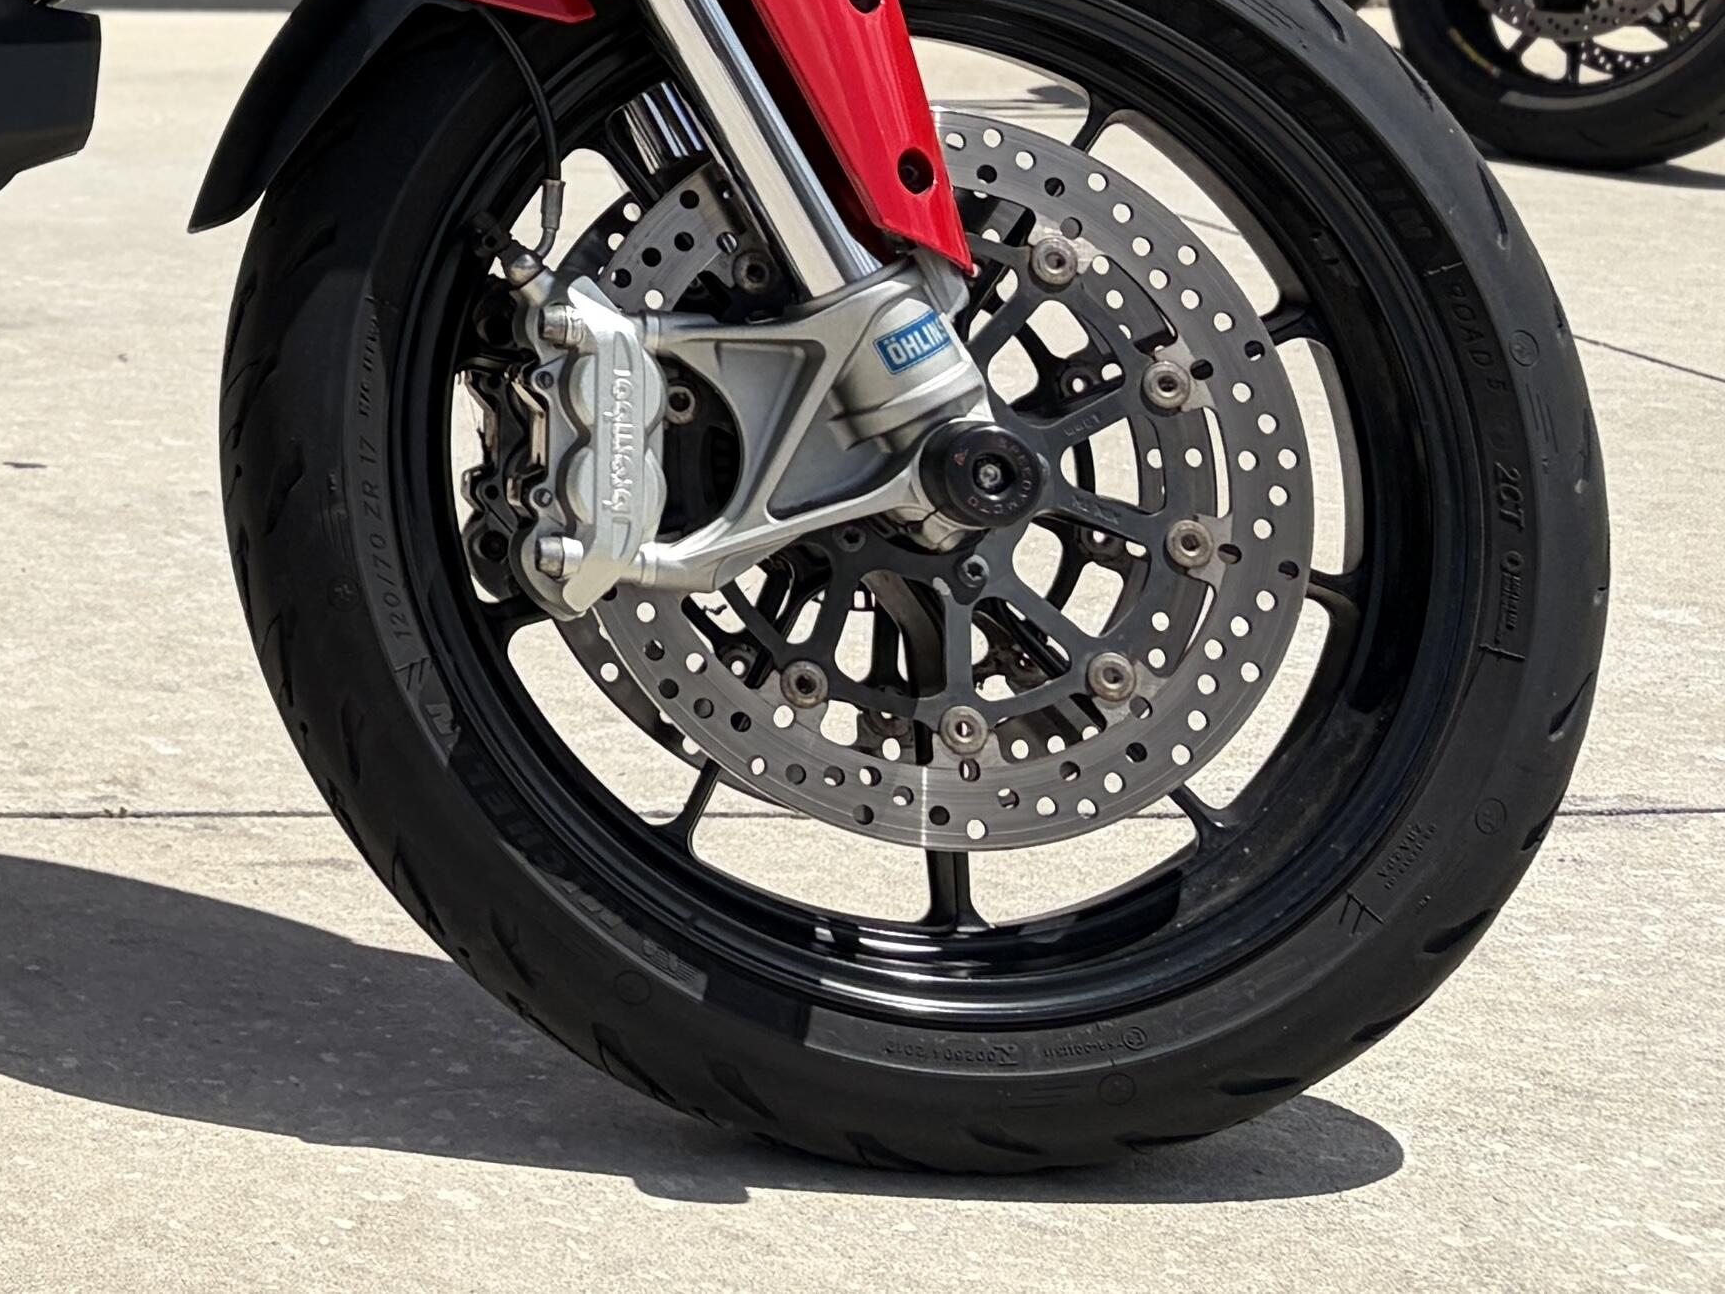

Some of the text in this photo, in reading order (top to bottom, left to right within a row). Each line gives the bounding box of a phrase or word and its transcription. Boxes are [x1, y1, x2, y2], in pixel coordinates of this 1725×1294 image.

[359, 435, 376, 464] 17
[362, 481, 382, 521] ZR
[1493, 459, 1525, 534] 2CT
[369, 532, 412, 640] 120/70
